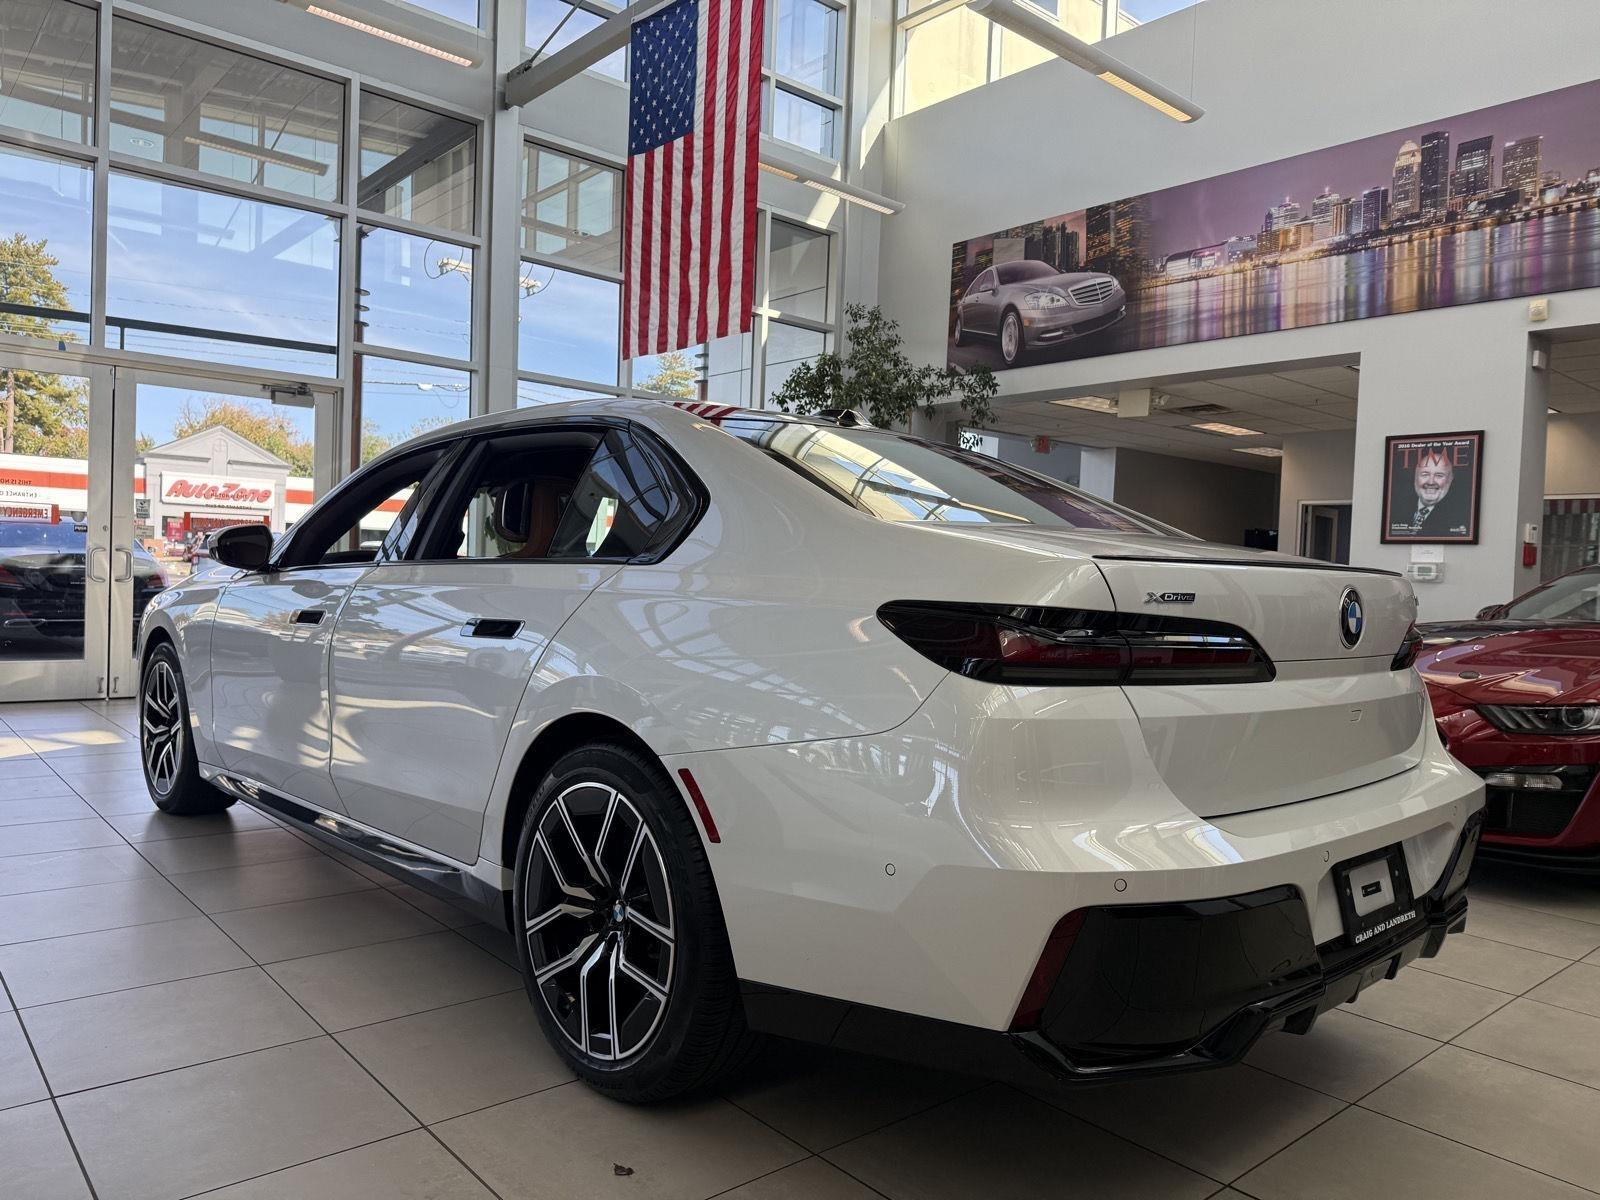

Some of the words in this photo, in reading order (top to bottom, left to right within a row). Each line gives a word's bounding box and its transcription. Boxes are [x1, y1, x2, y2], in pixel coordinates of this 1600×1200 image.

[1397, 446, 1470, 470] TIME
[165, 479, 273, 503] AutoZone
[1355, 929, 1373, 944] CRAIG
[1373, 923, 1386, 936] AND
[1385, 910, 1416, 929] LANDRETH
